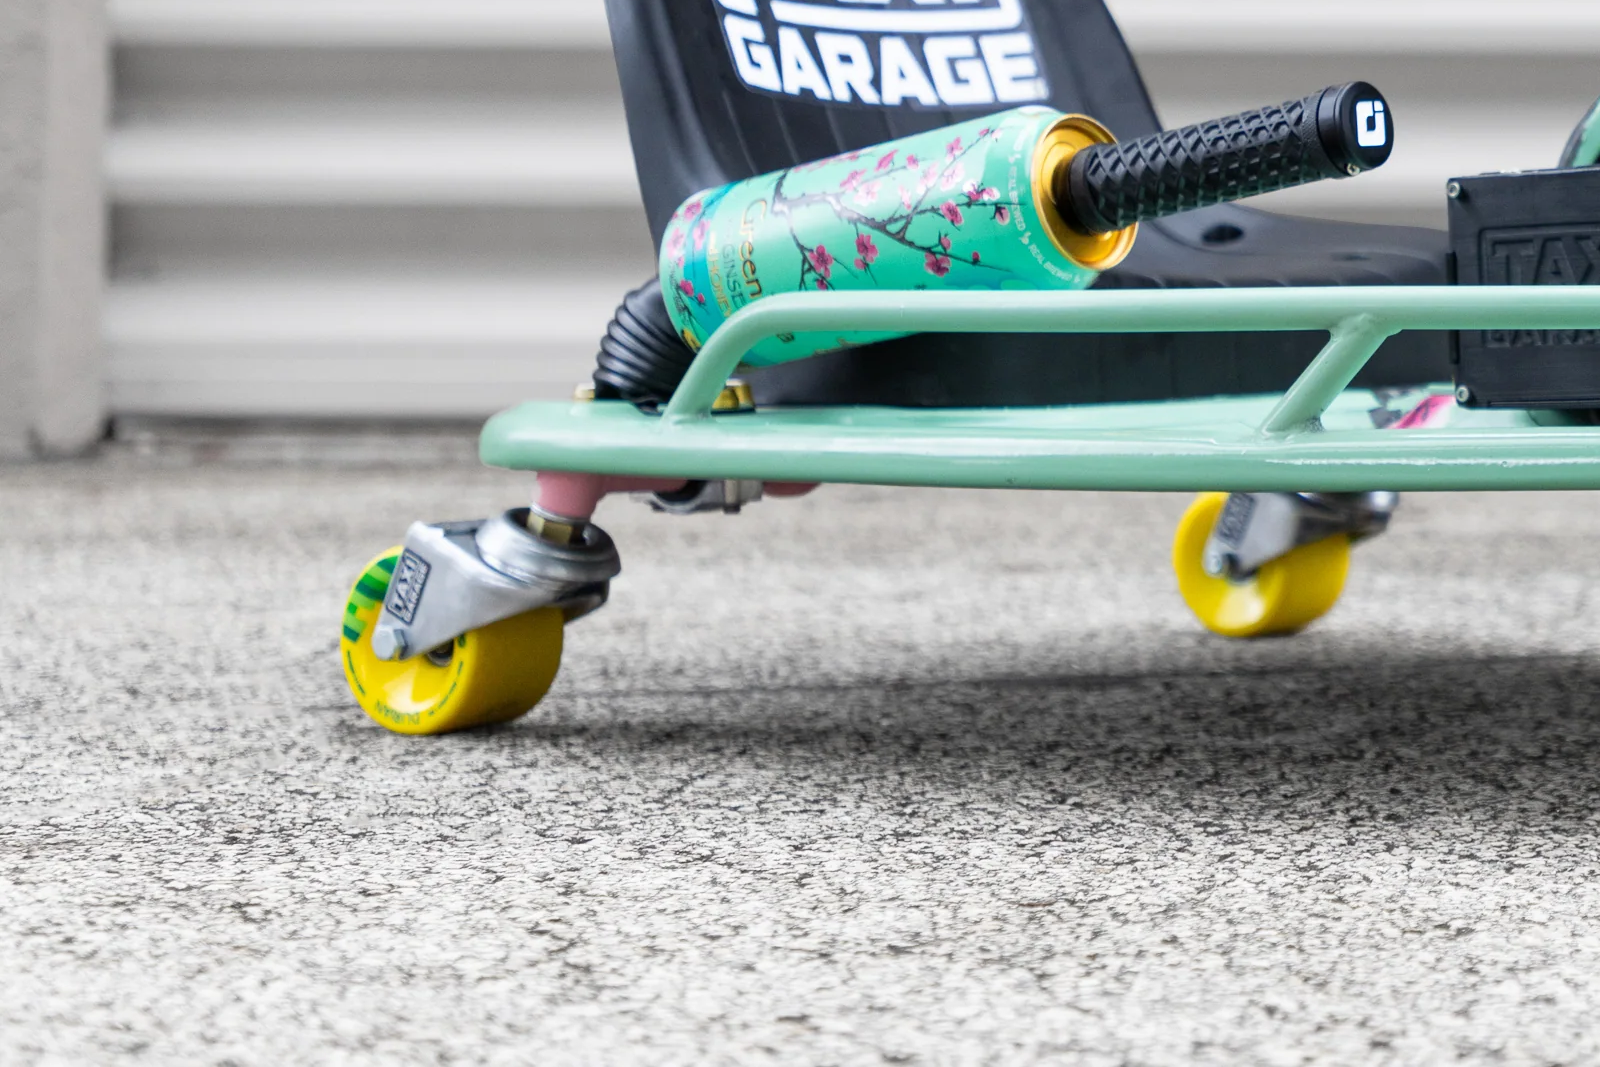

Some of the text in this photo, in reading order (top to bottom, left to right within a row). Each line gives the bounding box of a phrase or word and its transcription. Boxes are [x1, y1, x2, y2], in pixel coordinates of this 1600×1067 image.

[723, 13, 1049, 106] GARAGE
[721, 243, 747, 309] GINSE
[739, 198, 767, 298] Green
